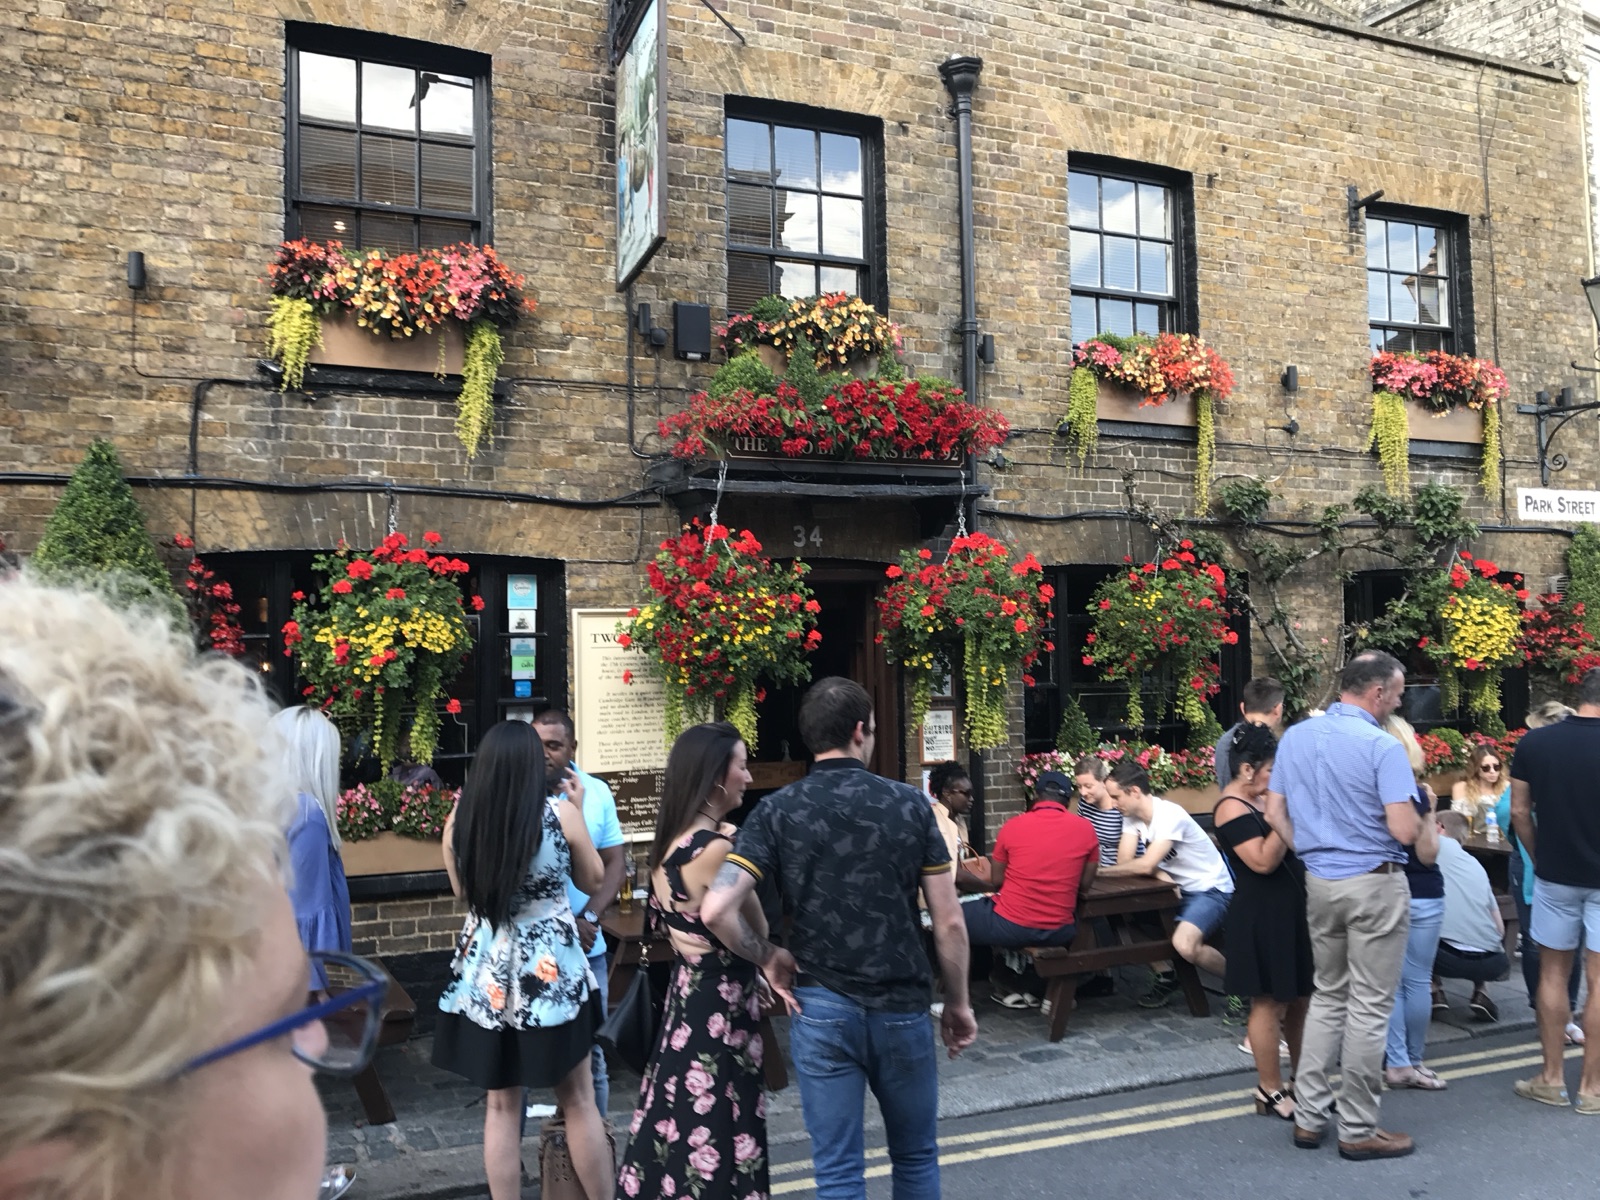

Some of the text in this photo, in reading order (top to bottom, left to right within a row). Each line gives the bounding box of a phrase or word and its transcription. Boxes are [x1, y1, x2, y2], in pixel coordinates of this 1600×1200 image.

[731, 436, 768, 452] THE
[1525, 495, 1595, 515] PARK STREET
[793, 525, 823, 548] 34
